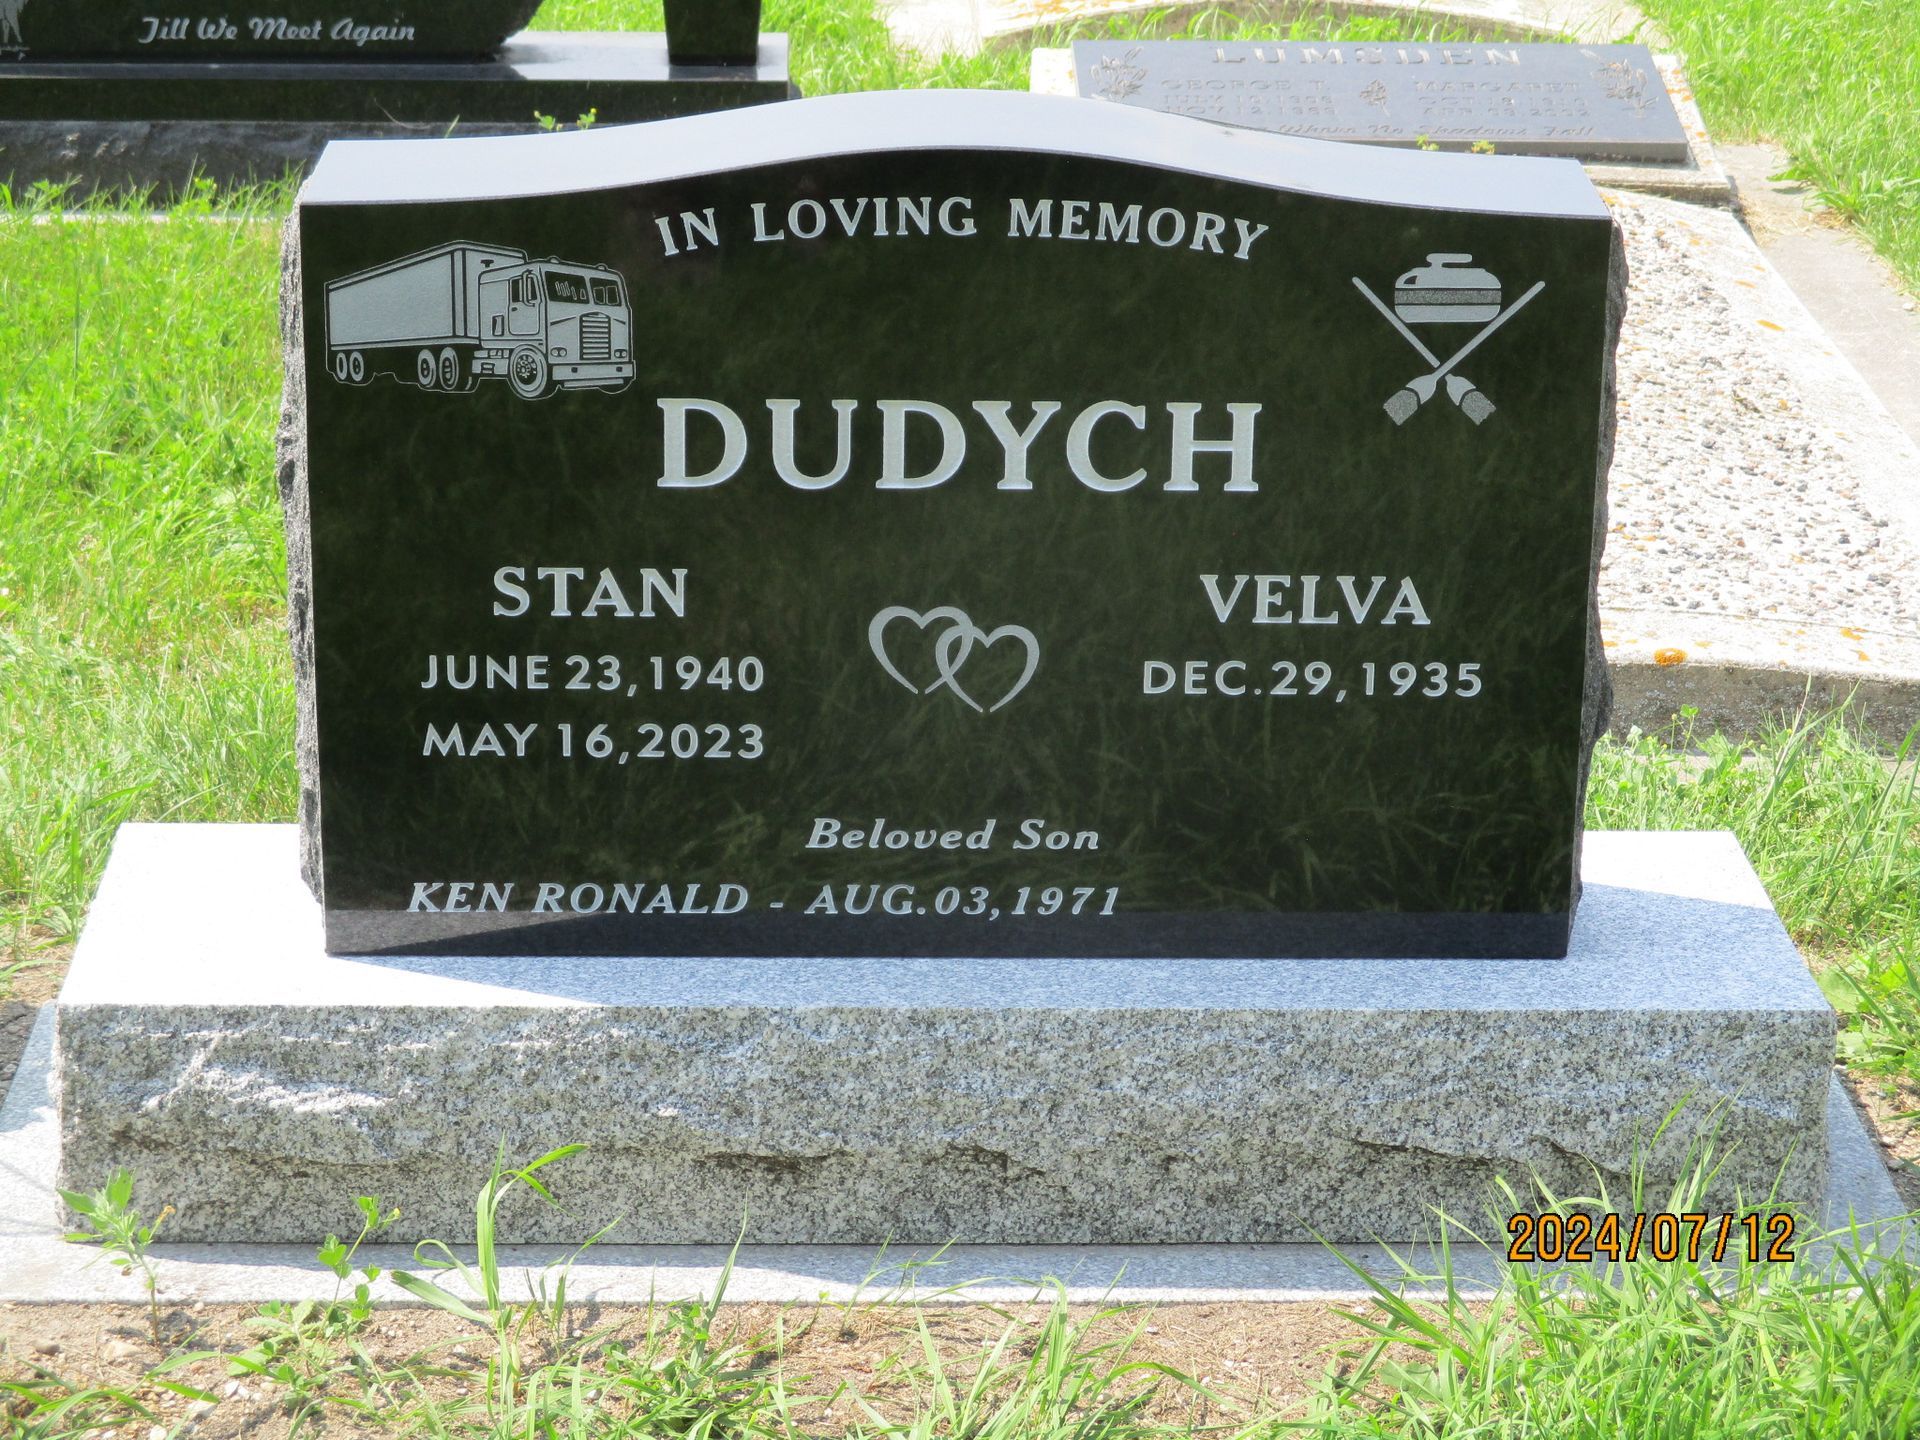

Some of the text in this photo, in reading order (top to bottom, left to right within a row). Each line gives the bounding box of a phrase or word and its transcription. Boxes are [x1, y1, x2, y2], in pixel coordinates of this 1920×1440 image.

[138, 15, 415, 47] Till We Meet Again
[1212, 47, 1521, 66] LUMSDEN
[1161, 79, 1292, 90] GEORGE
[1415, 80, 1581, 92] MARGARET
[1543, 125, 1595, 136] Fall
[654, 196, 1269, 260] IN LOVING MEMORY
[656, 397, 1263, 493] DUDYCH
[493, 566, 688, 618] STAN
[1199, 574, 1432, 626] VELVA
[420, 654, 764, 697] JUNE 23,1940
[422, 722, 764, 765] MAY 16,2023
[804, 817, 1099, 850] Beloved Son
[406, 882, 514, 914] KEN
[530, 882, 748, 915] RONALD
[804, 884, 1120, 921] AUG.03,1971
